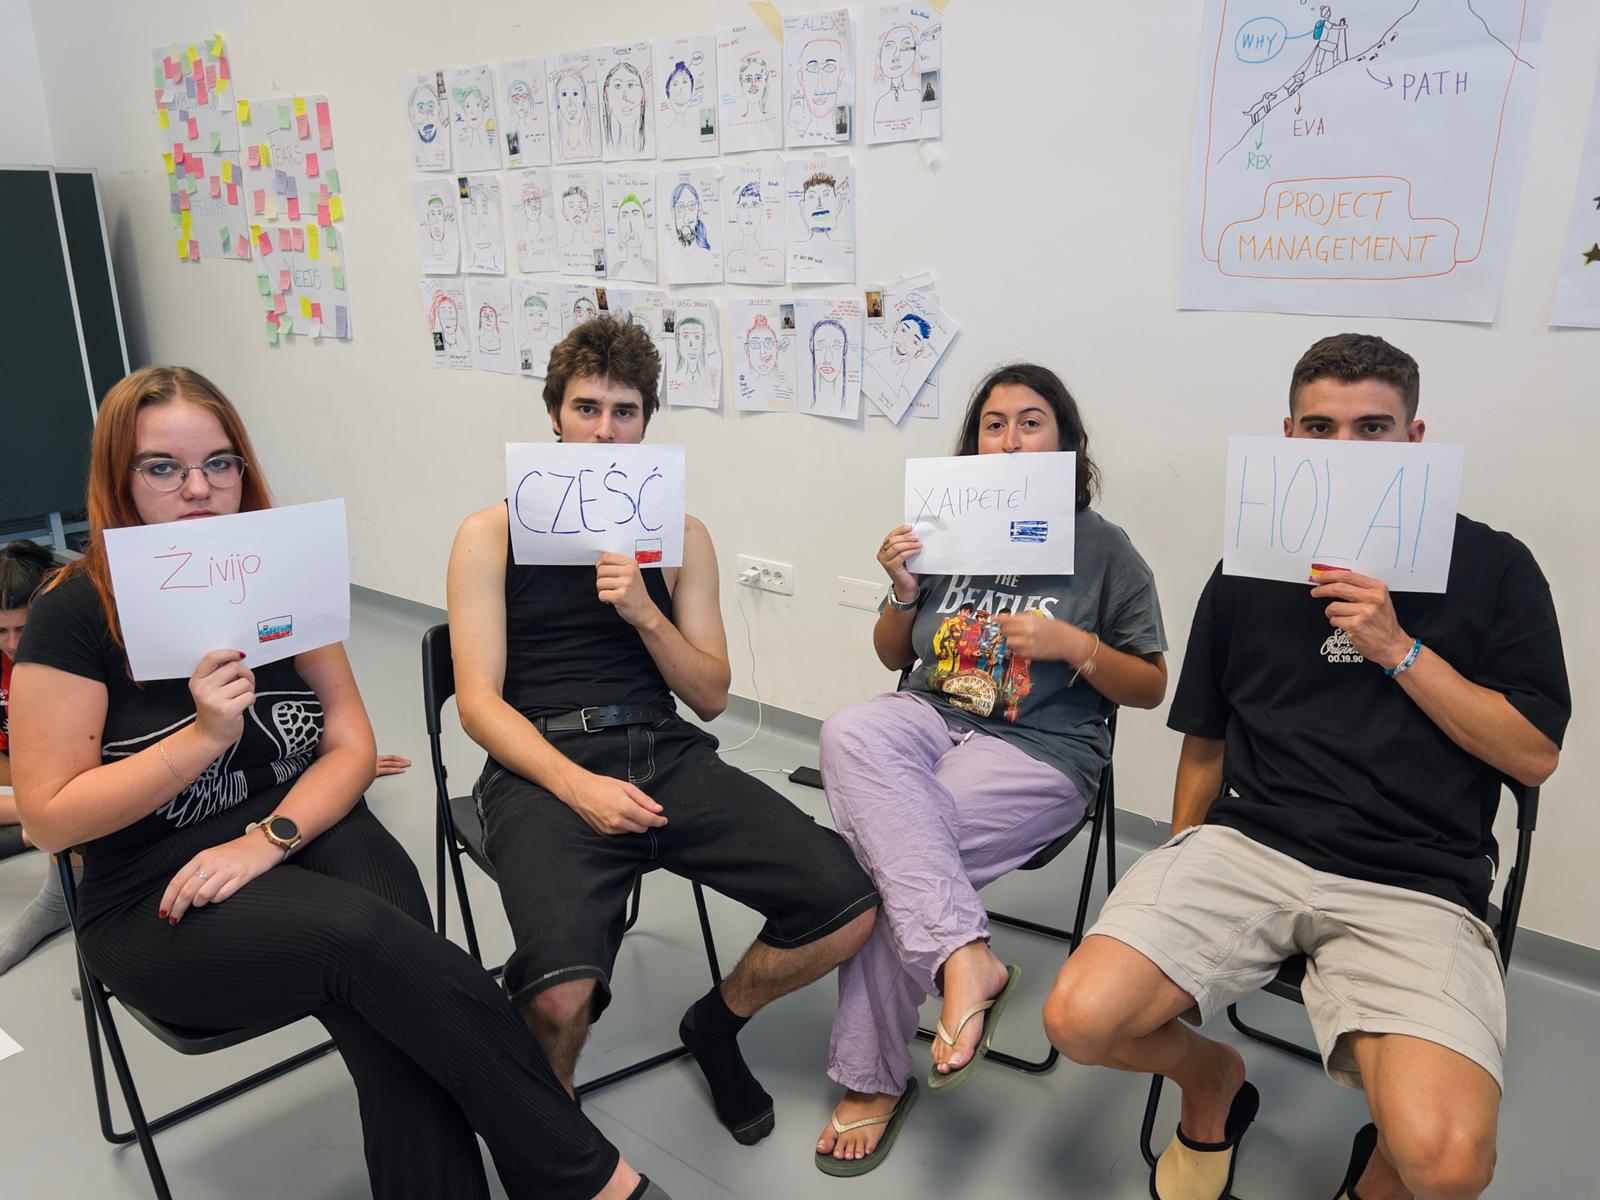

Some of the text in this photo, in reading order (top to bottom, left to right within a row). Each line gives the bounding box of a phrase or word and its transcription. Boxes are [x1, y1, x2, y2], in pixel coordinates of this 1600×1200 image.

[801, 15, 839, 31] ALEX
[1241, 33, 1280, 56] WHY
[1402, 70, 1469, 101] PATH
[1292, 117, 1326, 137] EVA
[1246, 153, 1273, 170] REX
[1276, 189, 1393, 226] PROJECT
[1238, 234, 1438, 264] MANAGEMENT
[515, 462, 663, 534] CZEŚĆ
[153, 545, 262, 605] Živijo
[994, 574, 1021, 588] THE
